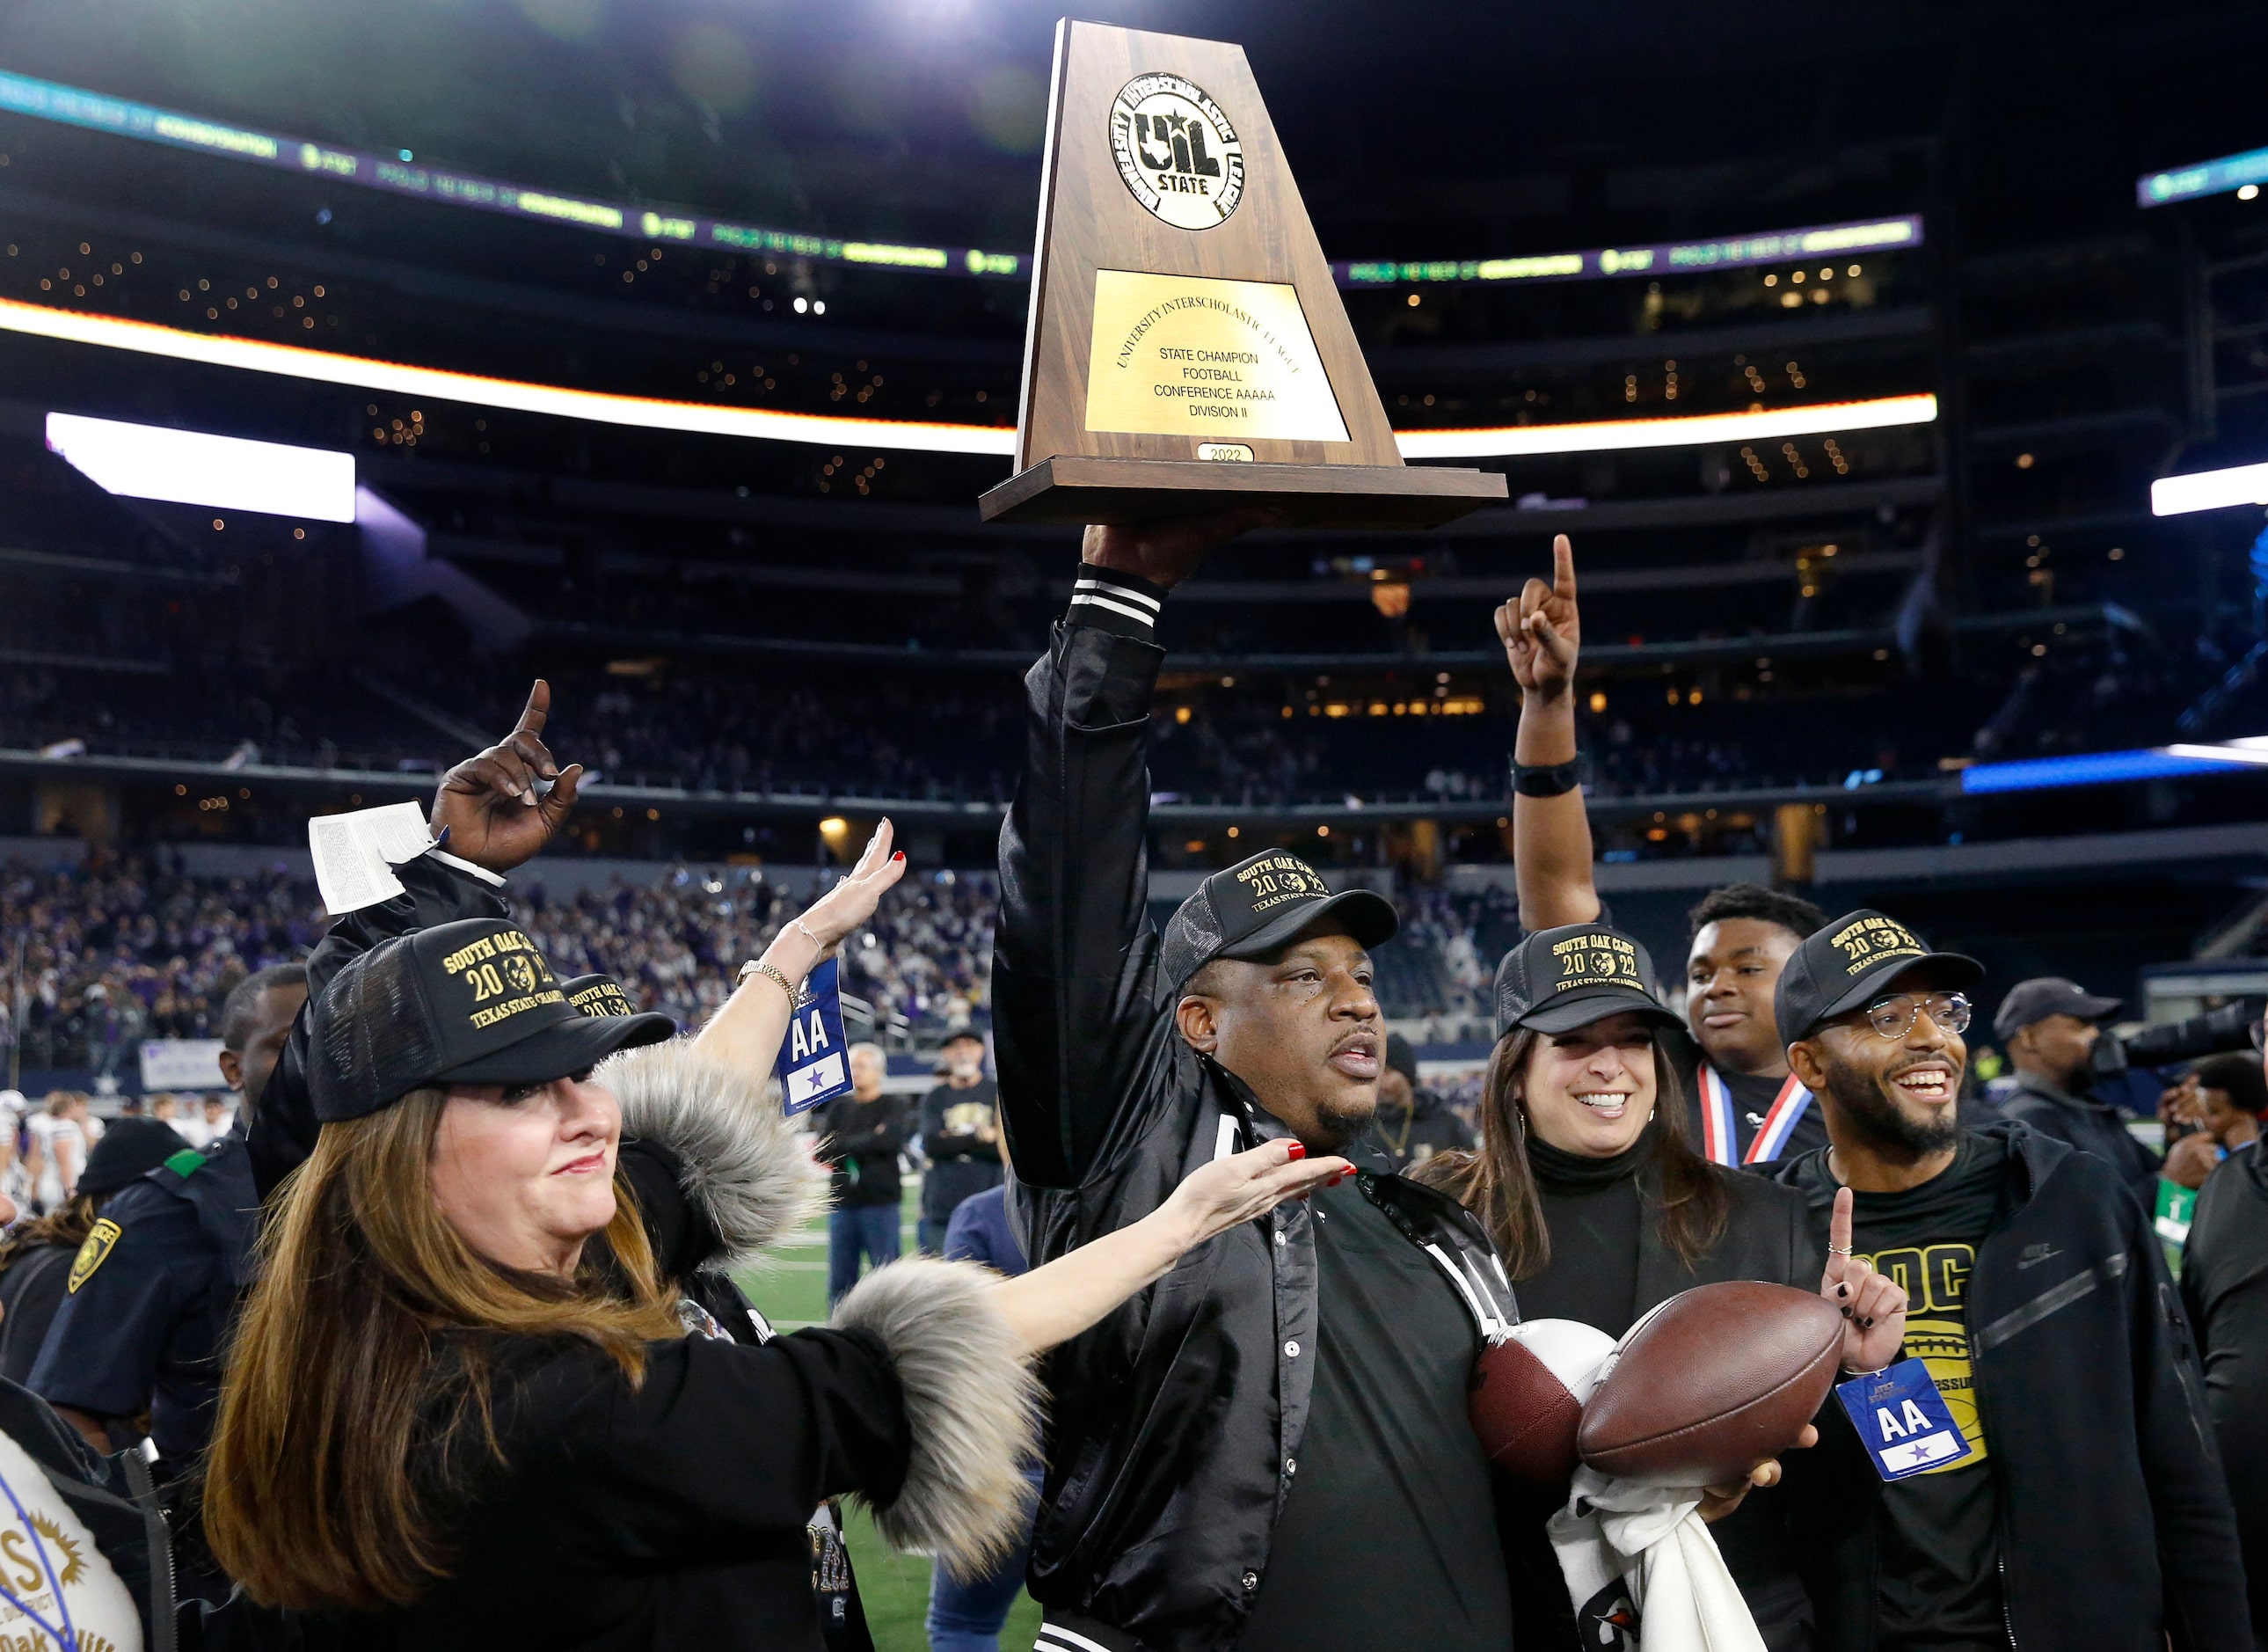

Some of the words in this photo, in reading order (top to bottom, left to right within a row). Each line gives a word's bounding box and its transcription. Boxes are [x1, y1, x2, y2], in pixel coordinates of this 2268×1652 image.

[1157, 173, 1209, 195] STATE
[1117, 307, 1163, 369] UNIVERSITY
[1162, 296, 1263, 333] INTERSCHOLASTIC
[1160, 347, 1194, 362] STATE
[1197, 350, 1258, 364] CHAMPION
[1183, 368, 1243, 382] FOOTBALL
[1154, 384, 1233, 399] CONFERENCE
[1236, 390, 1275, 401] AAAAA
[1189, 405, 1238, 418] DIVISION
[1242, 407, 1248, 418] II
[1211, 448, 1241, 462] 2022
[1236, 859, 1274, 882] SOUTH
[1273, 856, 1297, 870] OAK
[1251, 874, 1278, 897] 20
[1251, 895, 1281, 912] TEXAS
[1830, 920, 1866, 948] SOUTH
[1863, 917, 1888, 930] OAK
[443, 937, 497, 975] SOUTH
[493, 930, 522, 953] OAK
[1552, 935, 1589, 956] SOUTH
[1590, 934, 1611, 949] OAK
[1612, 938, 1635, 956] CLIFF
[1844, 937, 1871, 961] 20
[1563, 953, 1586, 976] 20
[1619, 954, 1637, 976] 22
[1846, 956, 1875, 976] TEXAS
[465, 963, 504, 1002] 20
[1555, 978, 1584, 992] TEXAS
[568, 986, 604, 1007] SOUTH
[600, 983, 621, 996] OAK
[470, 1003, 511, 1029] TEXAS
[507, 996, 538, 1014] STATE
[792, 1008, 829, 1063] AA
[1851, 1243, 1975, 1317] OC
[1877, 1399, 1933, 1443] AA
